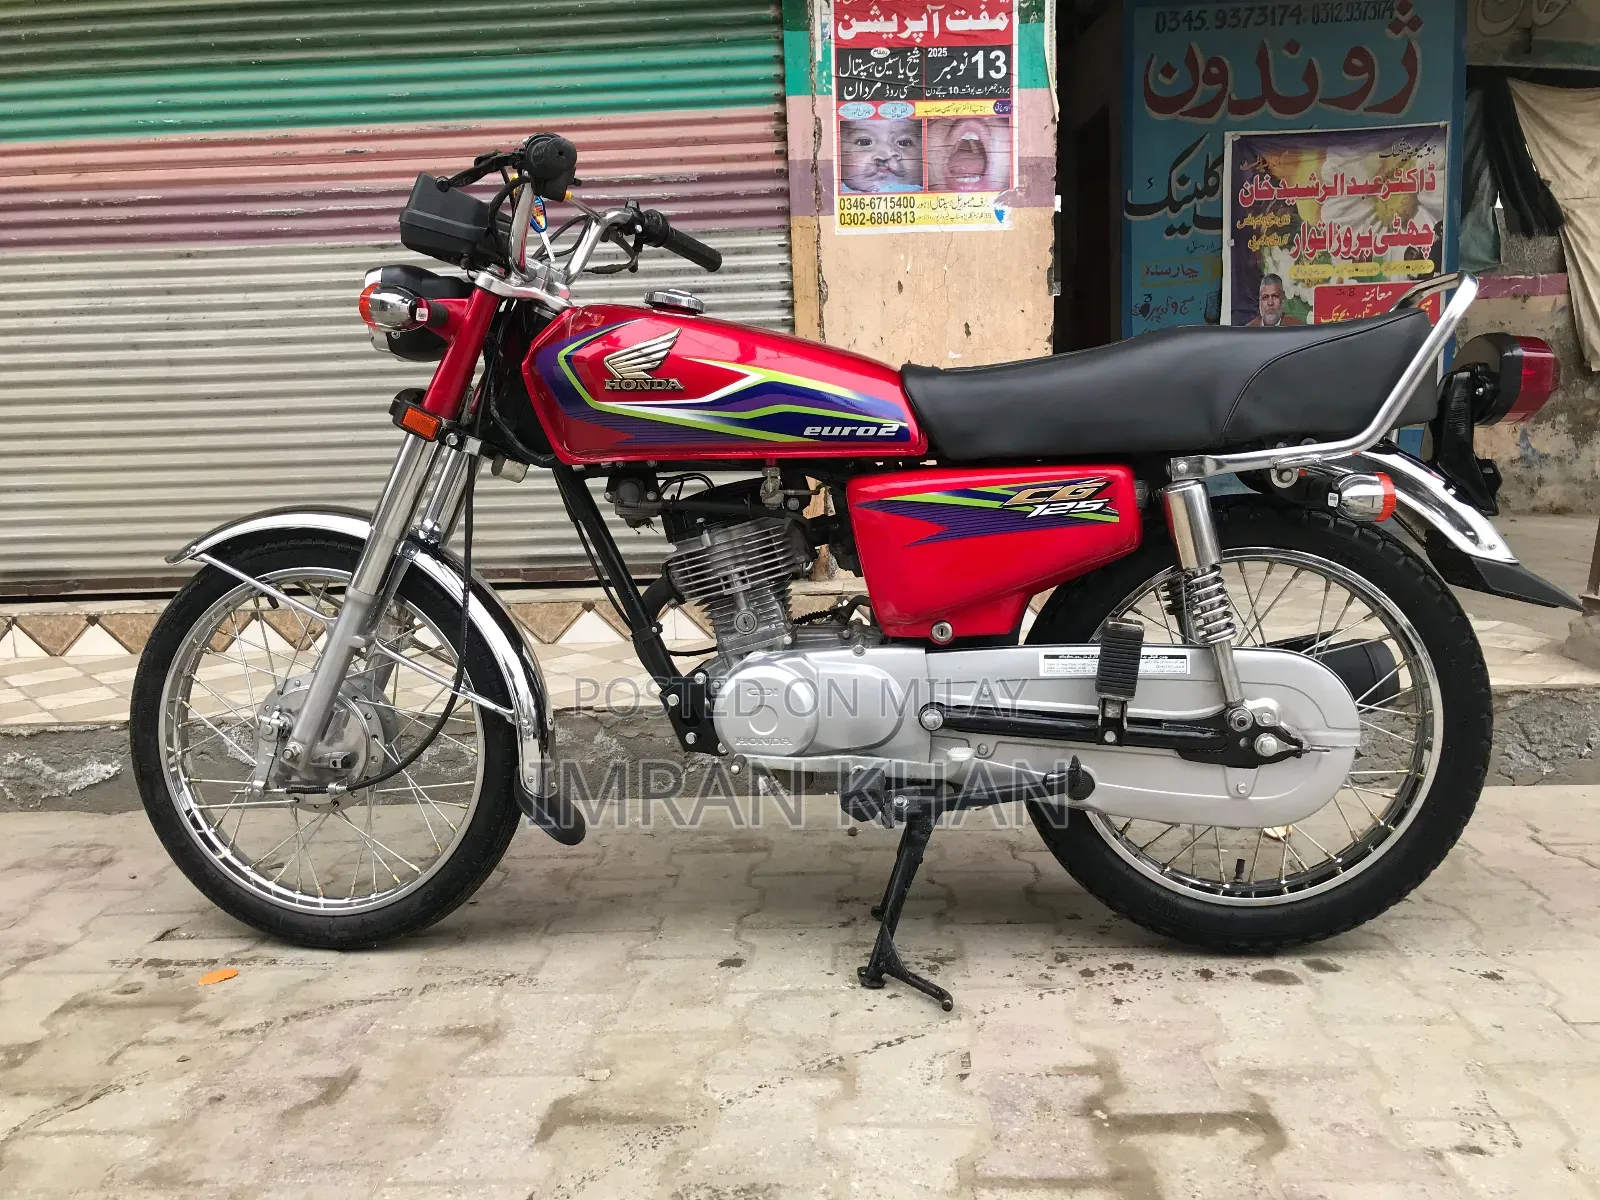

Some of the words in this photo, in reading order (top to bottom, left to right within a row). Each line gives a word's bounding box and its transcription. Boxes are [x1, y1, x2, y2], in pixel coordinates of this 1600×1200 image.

[837, 4, 945, 42] آپریشن
[946, 4, 1010, 31] مفت
[905, 47, 921, 77] شیخ
[927, 47, 948, 57] 2025
[839, 54, 876, 78] ہسپتال
[874, 56, 905, 79] یاسین
[932, 51, 969, 83] نومبر
[971, 49, 1007, 79] 13
[843, 81, 882, 100] مردان
[884, 84, 899, 97] روڈ
[948, 86, 959, 94] 10
[1380, 161, 1437, 200] ڈاکٹر
[839, 196, 916, 211] 0346-6715400
[839, 211, 916, 226] 0302-6804813
[1374, 212, 1435, 259] چھٹی
[603, 378, 685, 392] HONDA
[803, 423, 900, 438] euro2
[1002, 480, 1107, 507] CG
[1025, 498, 1109, 519] 125
[735, 736, 793, 746] HONDA
